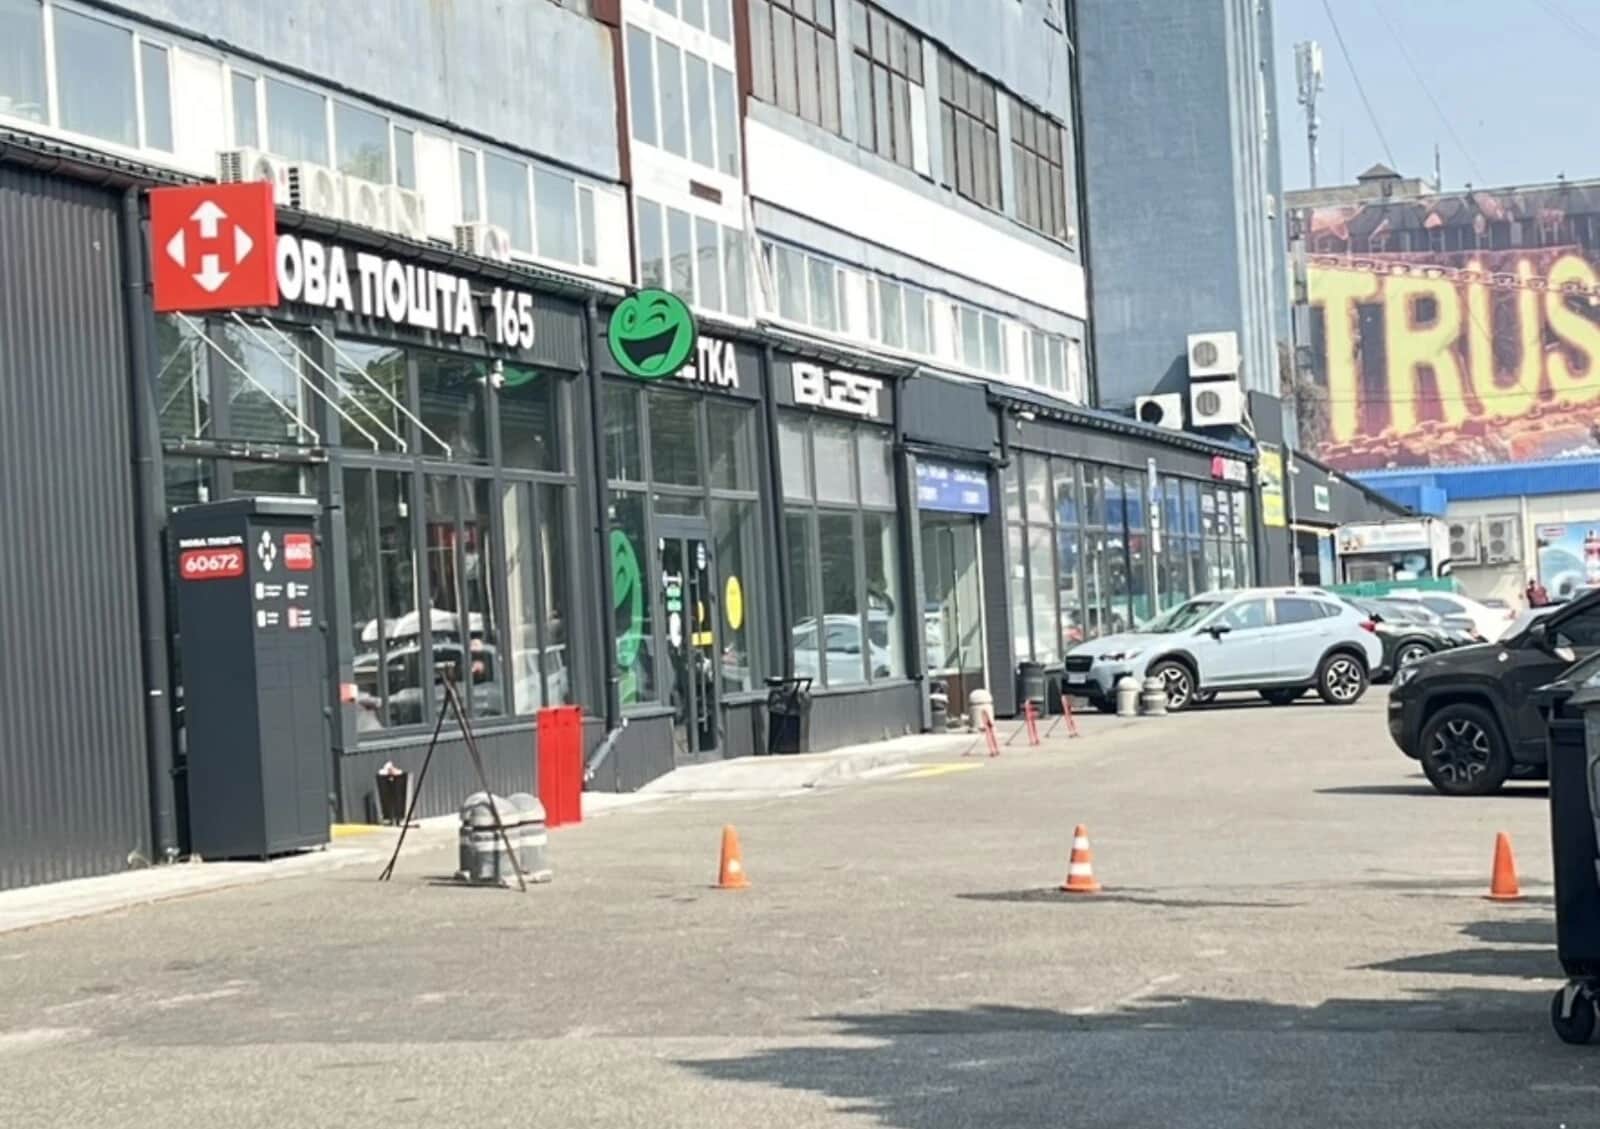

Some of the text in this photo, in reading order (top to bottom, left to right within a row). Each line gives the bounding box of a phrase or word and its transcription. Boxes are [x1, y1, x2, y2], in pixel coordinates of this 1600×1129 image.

[276, 233, 535, 350] ОВА ПОШТА 165
[683, 335, 739, 389] ТКА
[1307, 255, 1600, 442] TRUS
[185, 553, 239, 572] 60672
